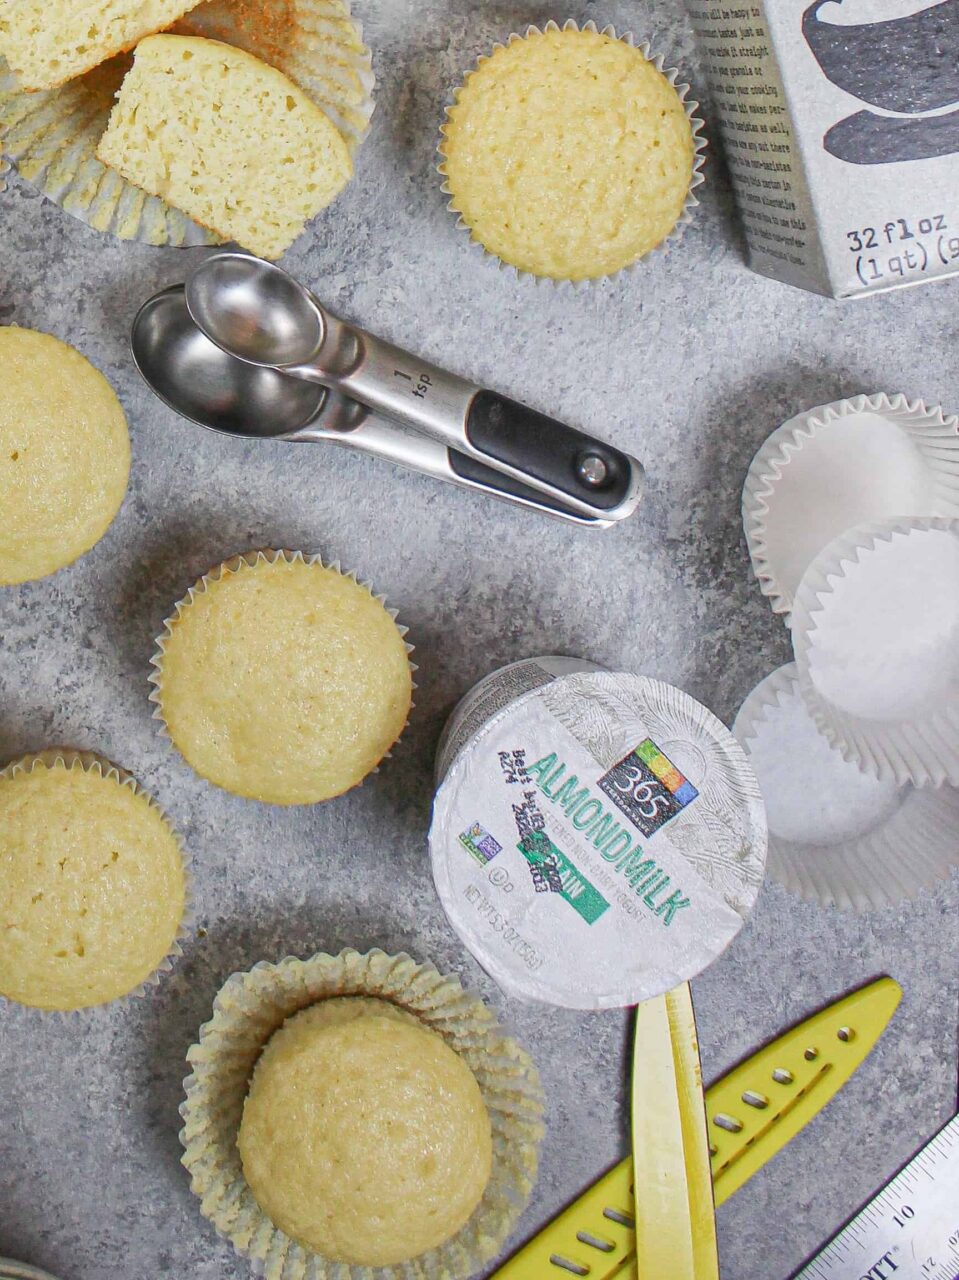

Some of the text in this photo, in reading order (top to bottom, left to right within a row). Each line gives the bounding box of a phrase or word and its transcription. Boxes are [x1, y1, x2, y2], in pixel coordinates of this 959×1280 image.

[846, 227, 878, 252] 32
[918, 214, 948, 234] oz
[412, 373, 433, 399] tsp
[613, 765, 671, 819] 365
[526, 751, 691, 927] ALMONDMILK
[892, 1205, 915, 1228] 10
